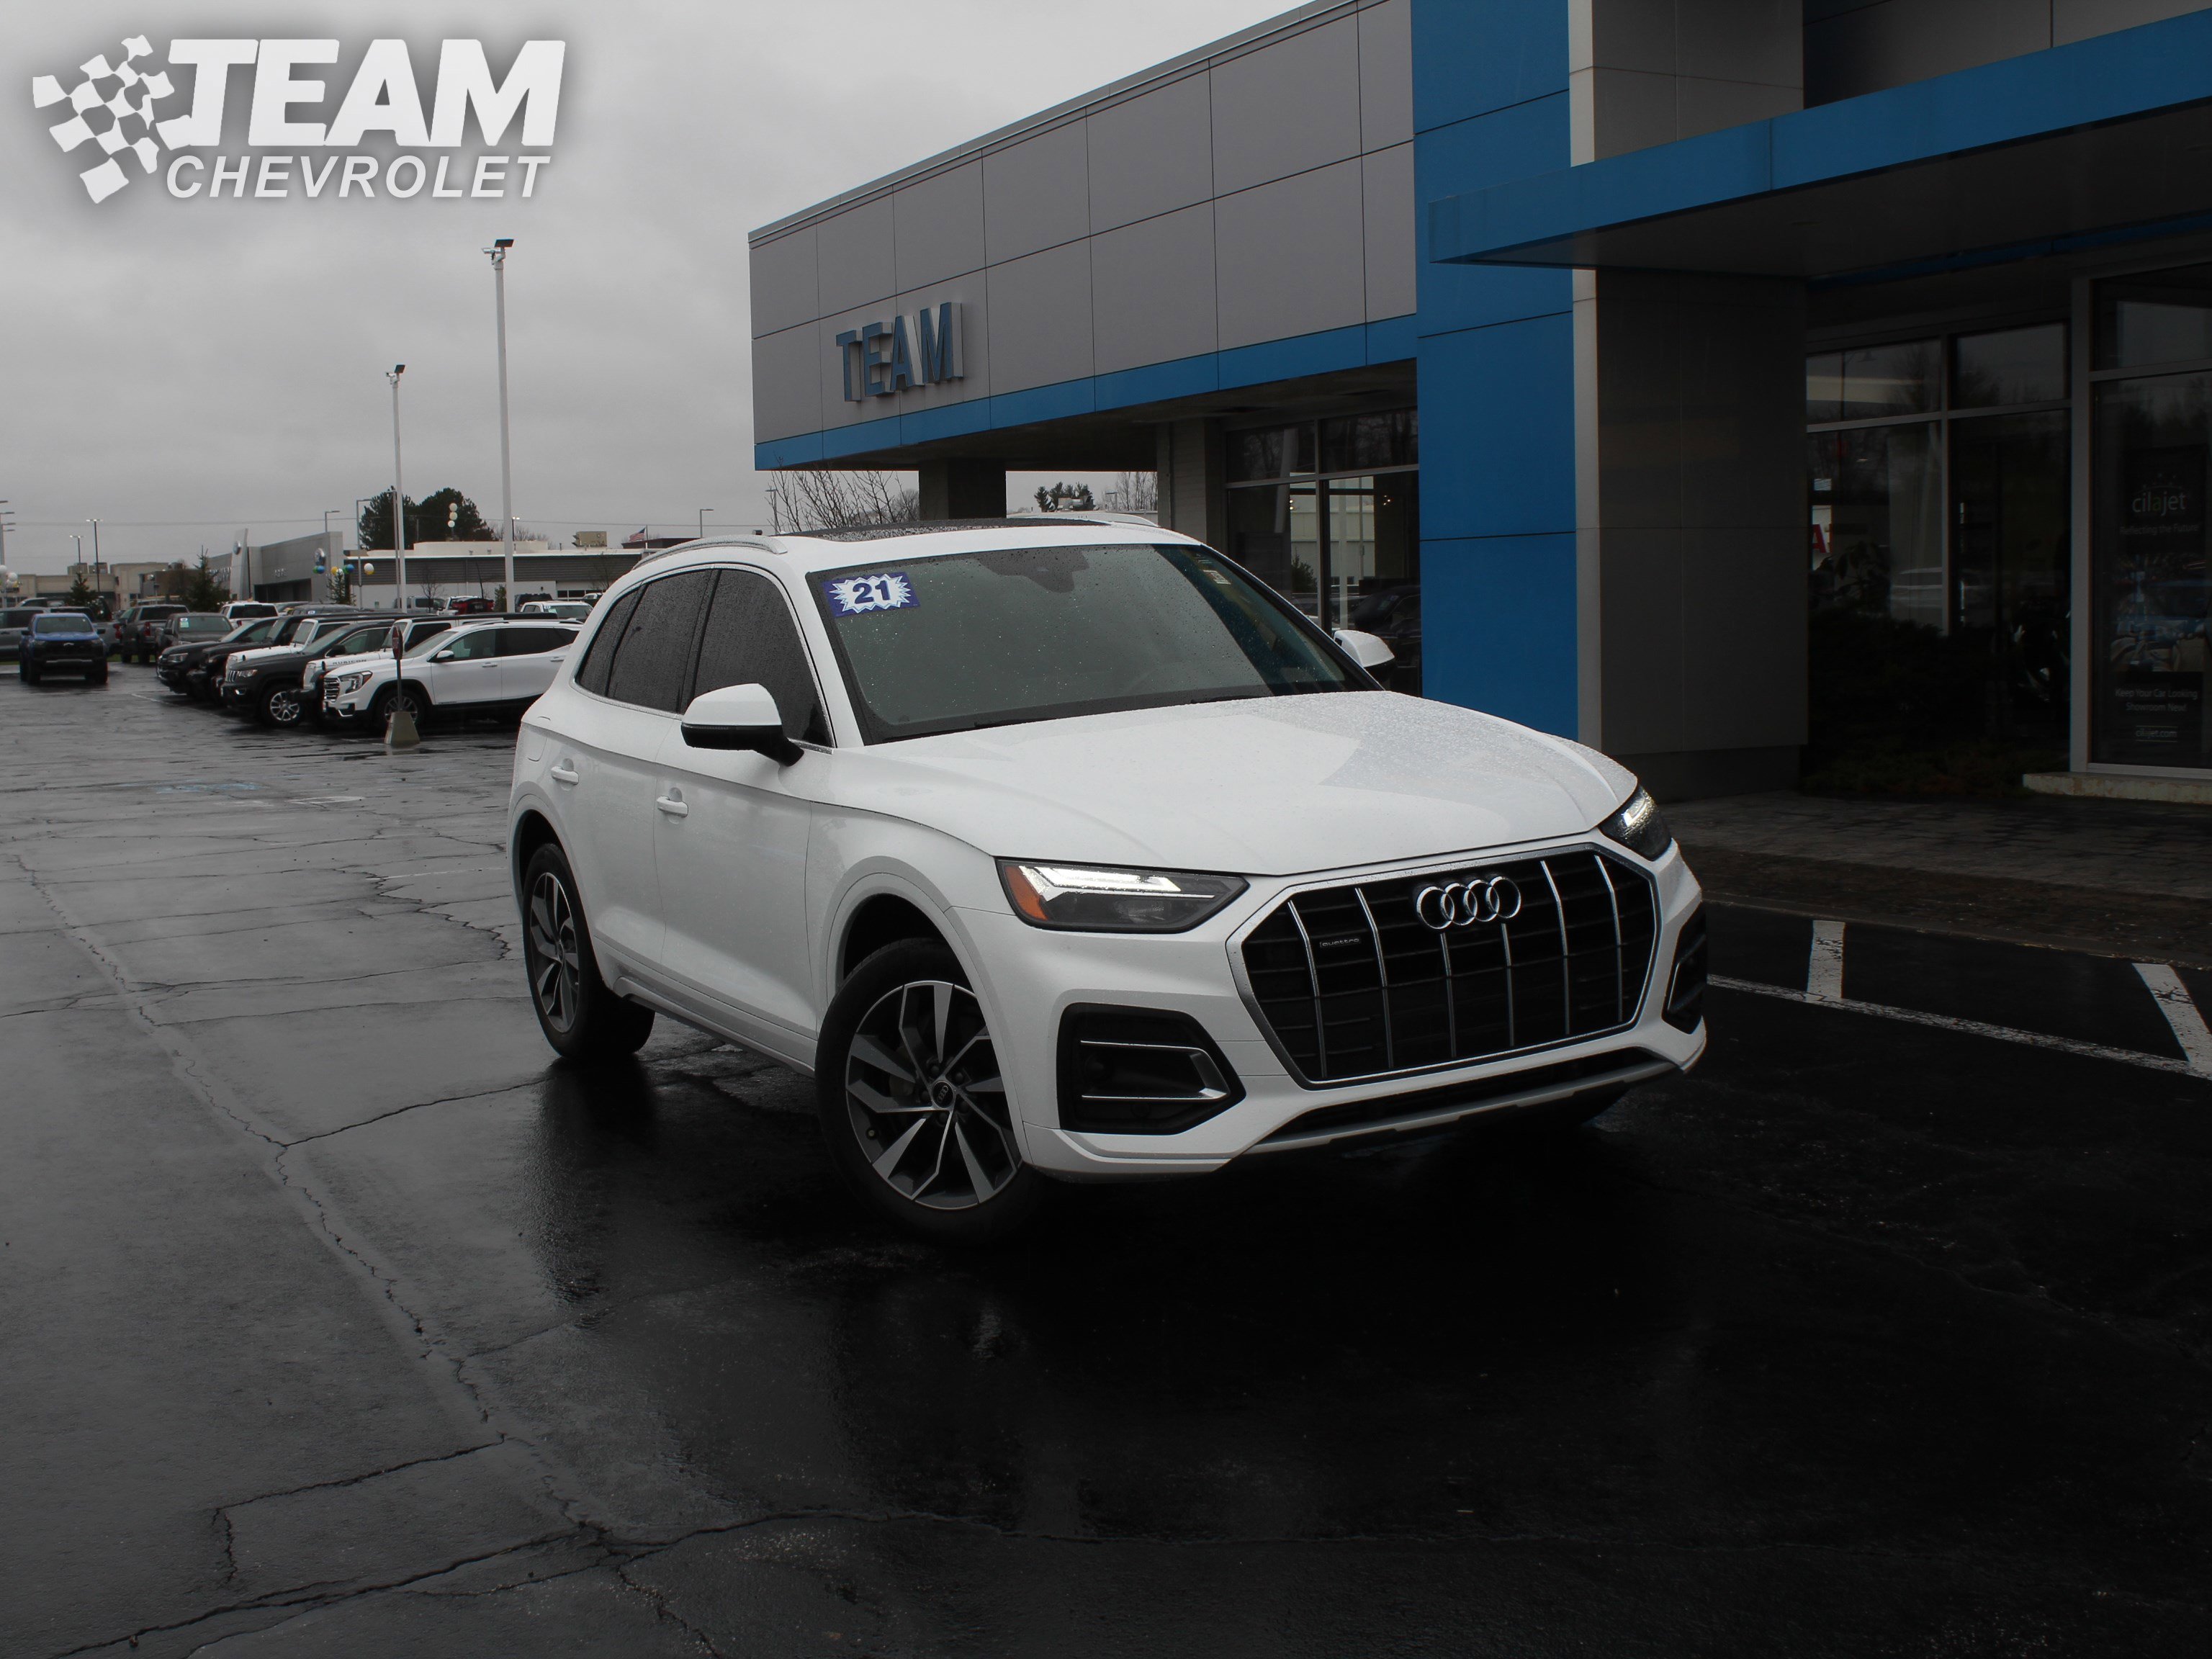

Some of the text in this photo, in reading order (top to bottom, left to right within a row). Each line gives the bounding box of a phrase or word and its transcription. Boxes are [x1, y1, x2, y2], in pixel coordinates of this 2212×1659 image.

[836, 301, 963, 402] TEAM
[2132, 490, 2187, 516] cilajet
[2119, 523, 2199, 536] Reflecting the Future
[853, 580, 891, 604] 21
[2115, 688, 2134, 698] Keep
[2136, 688, 2152, 697] Your
[2168, 689, 2198, 701] Looking
[2126, 702, 2166, 711] Showroom
[1322, 938, 1359, 947] quattro
